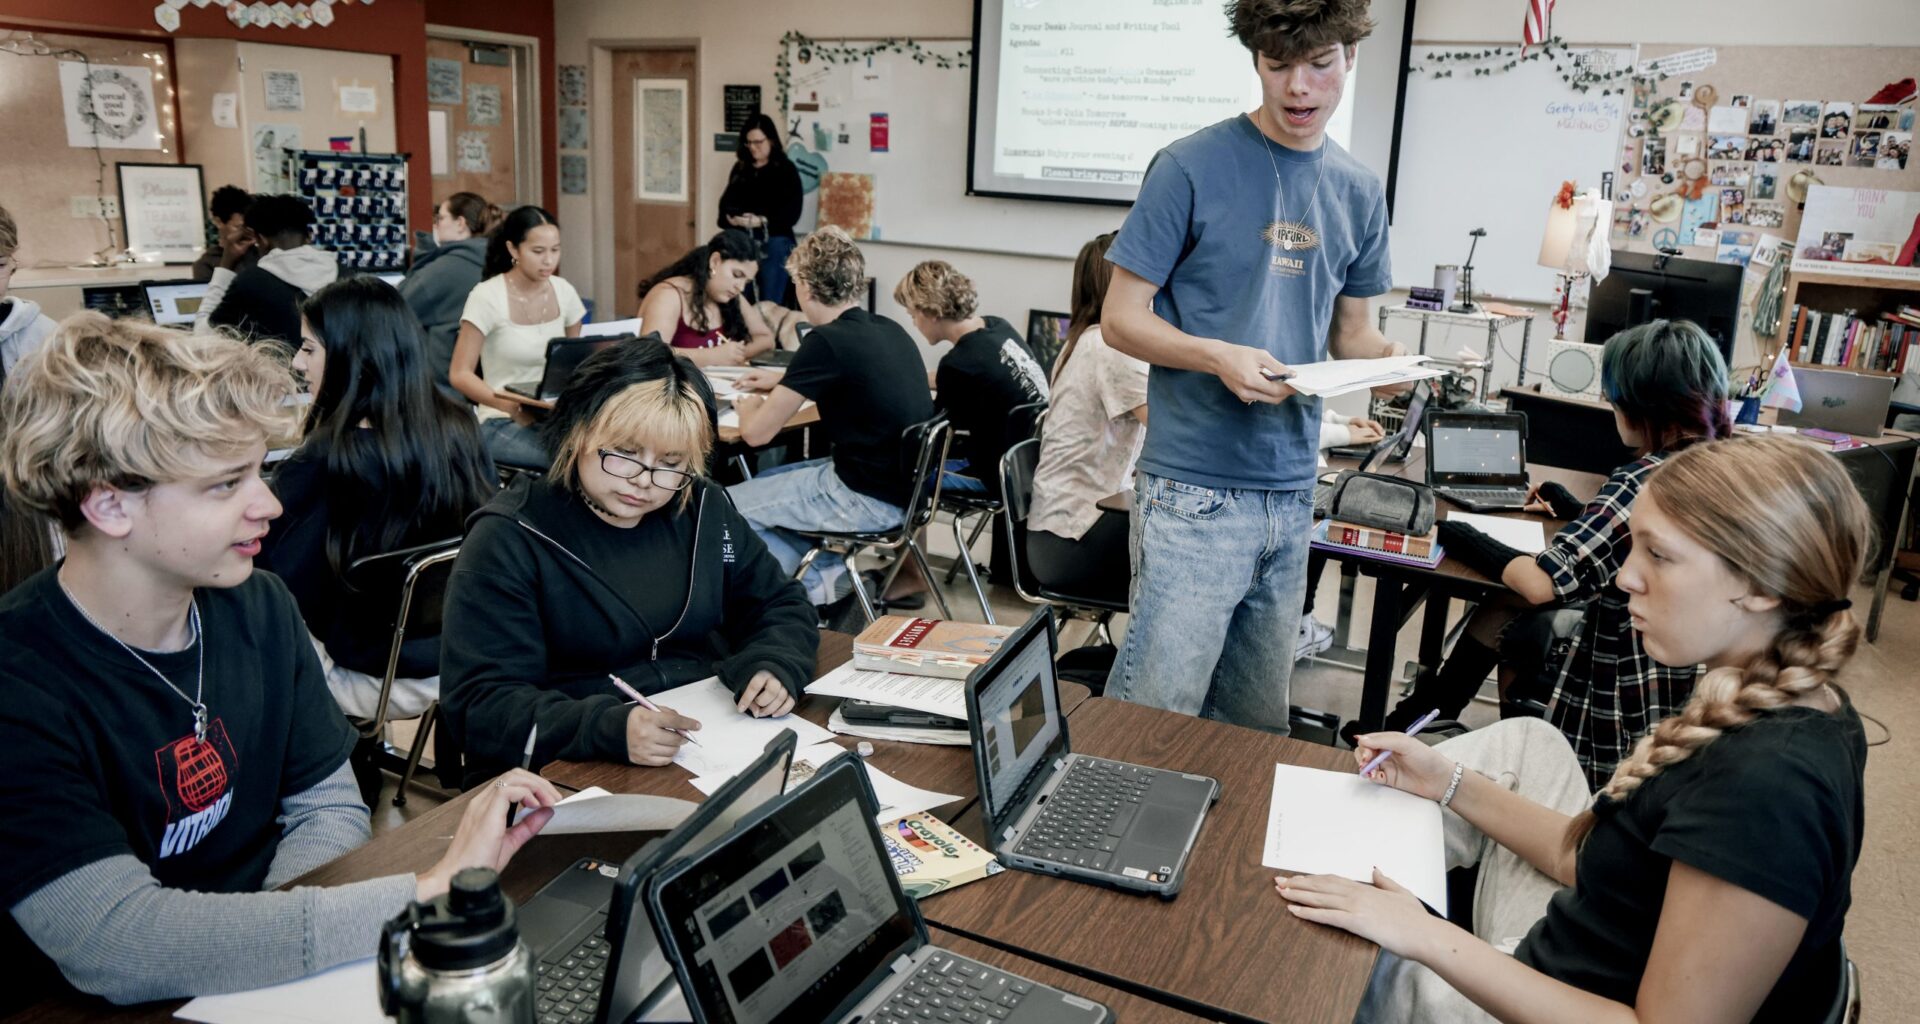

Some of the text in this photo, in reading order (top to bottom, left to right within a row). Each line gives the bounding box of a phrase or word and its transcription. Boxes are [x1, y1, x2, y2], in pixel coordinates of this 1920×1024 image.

[1009, 22, 1020, 31] On
[1022, 24, 1042, 32] your
[1069, 22, 1102, 31] Journal
[1105, 22, 1121, 31] and
[1123, 22, 1160, 32] Writing
[1161, 22, 1181, 31] Tool
[1009, 39, 1041, 48] Agenda:
[1023, 65, 1072, 75] Connecting
[1074, 66, 1107, 75] Clauses
[1063, 76, 1095, 84] practice
[98, 93, 126, 101] spread
[1172, 96, 1196, 105] ready
[1087, 109, 1127, 118] Tomorrow
[1545, 102, 1576, 118] Getty
[1071, 151, 1091, 161] your
[1851, 189, 1889, 205] THANK
[1857, 204, 1877, 219] YOU
[1271, 255, 1305, 269] HAWAII
[907, 820, 961, 858] Crayola
